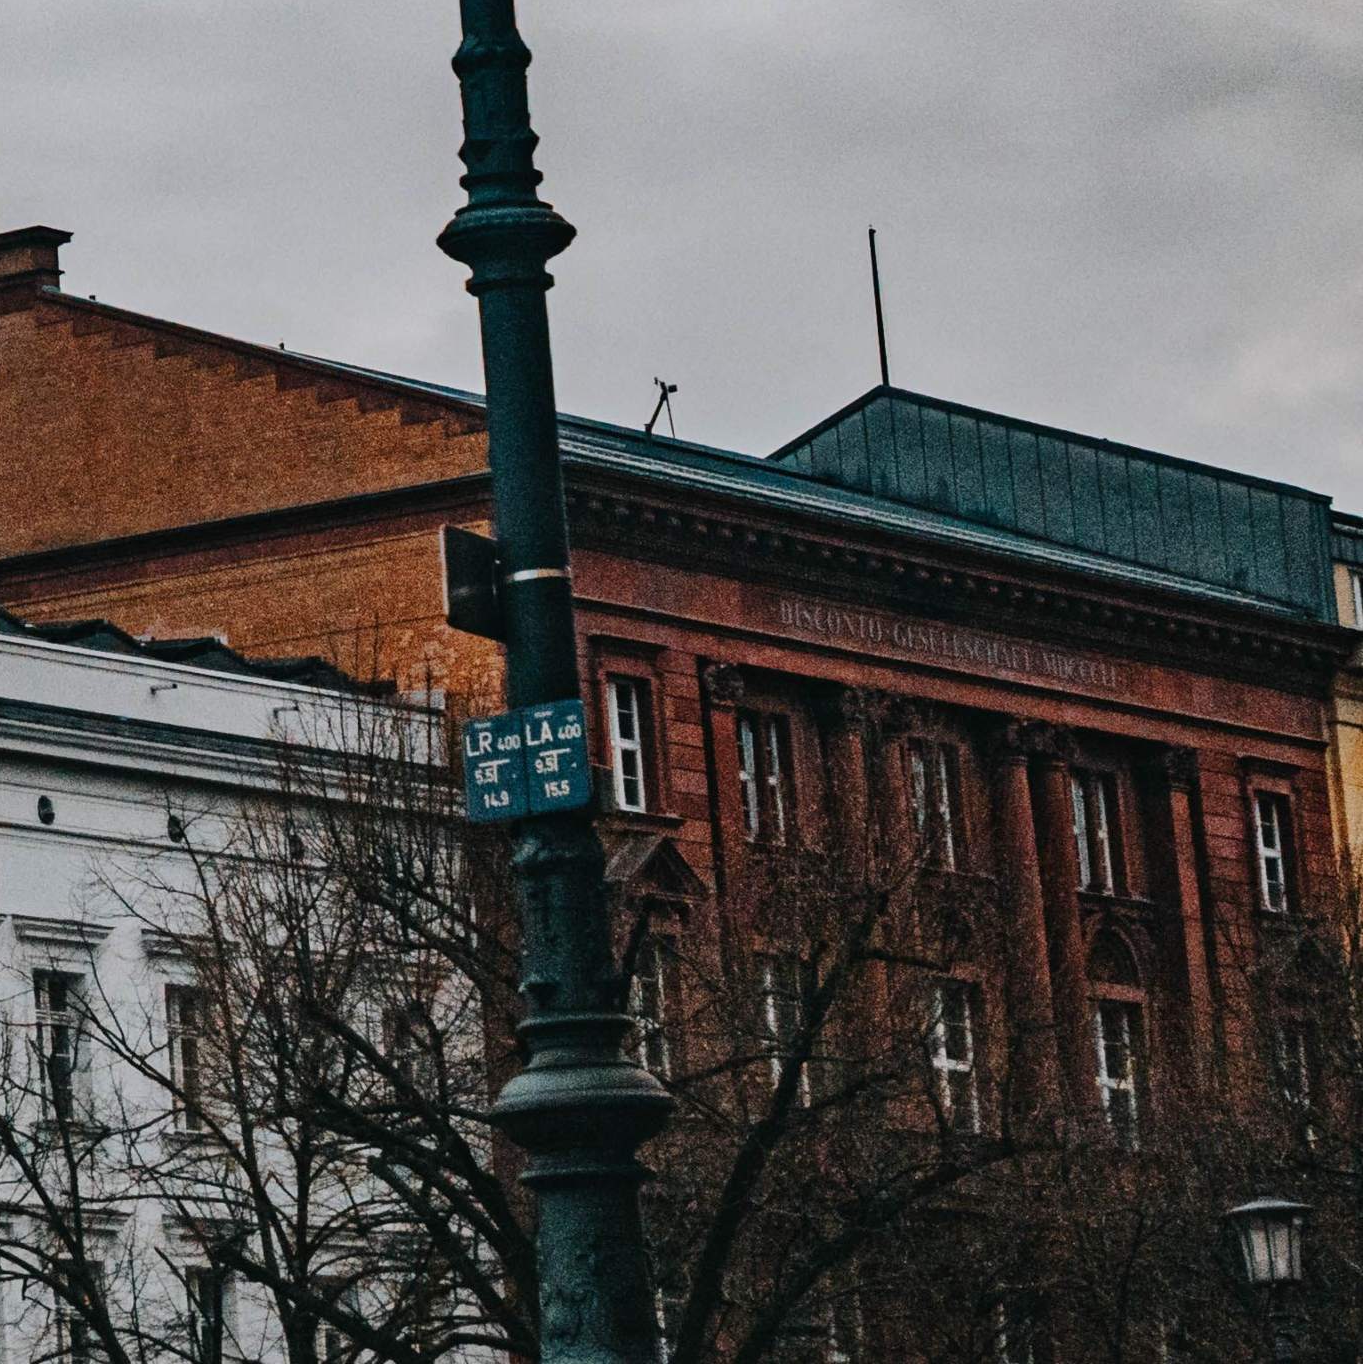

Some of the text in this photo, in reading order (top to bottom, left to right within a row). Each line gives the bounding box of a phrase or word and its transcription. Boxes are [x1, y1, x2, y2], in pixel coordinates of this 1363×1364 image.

[780, 599, 882, 643] DISCONTO
[465, 731, 522, 757] LR 400
[525, 720, 582, 746] LA 400
[483, 790, 510, 809] 14.9
[544, 779, 571, 798] 15.5
